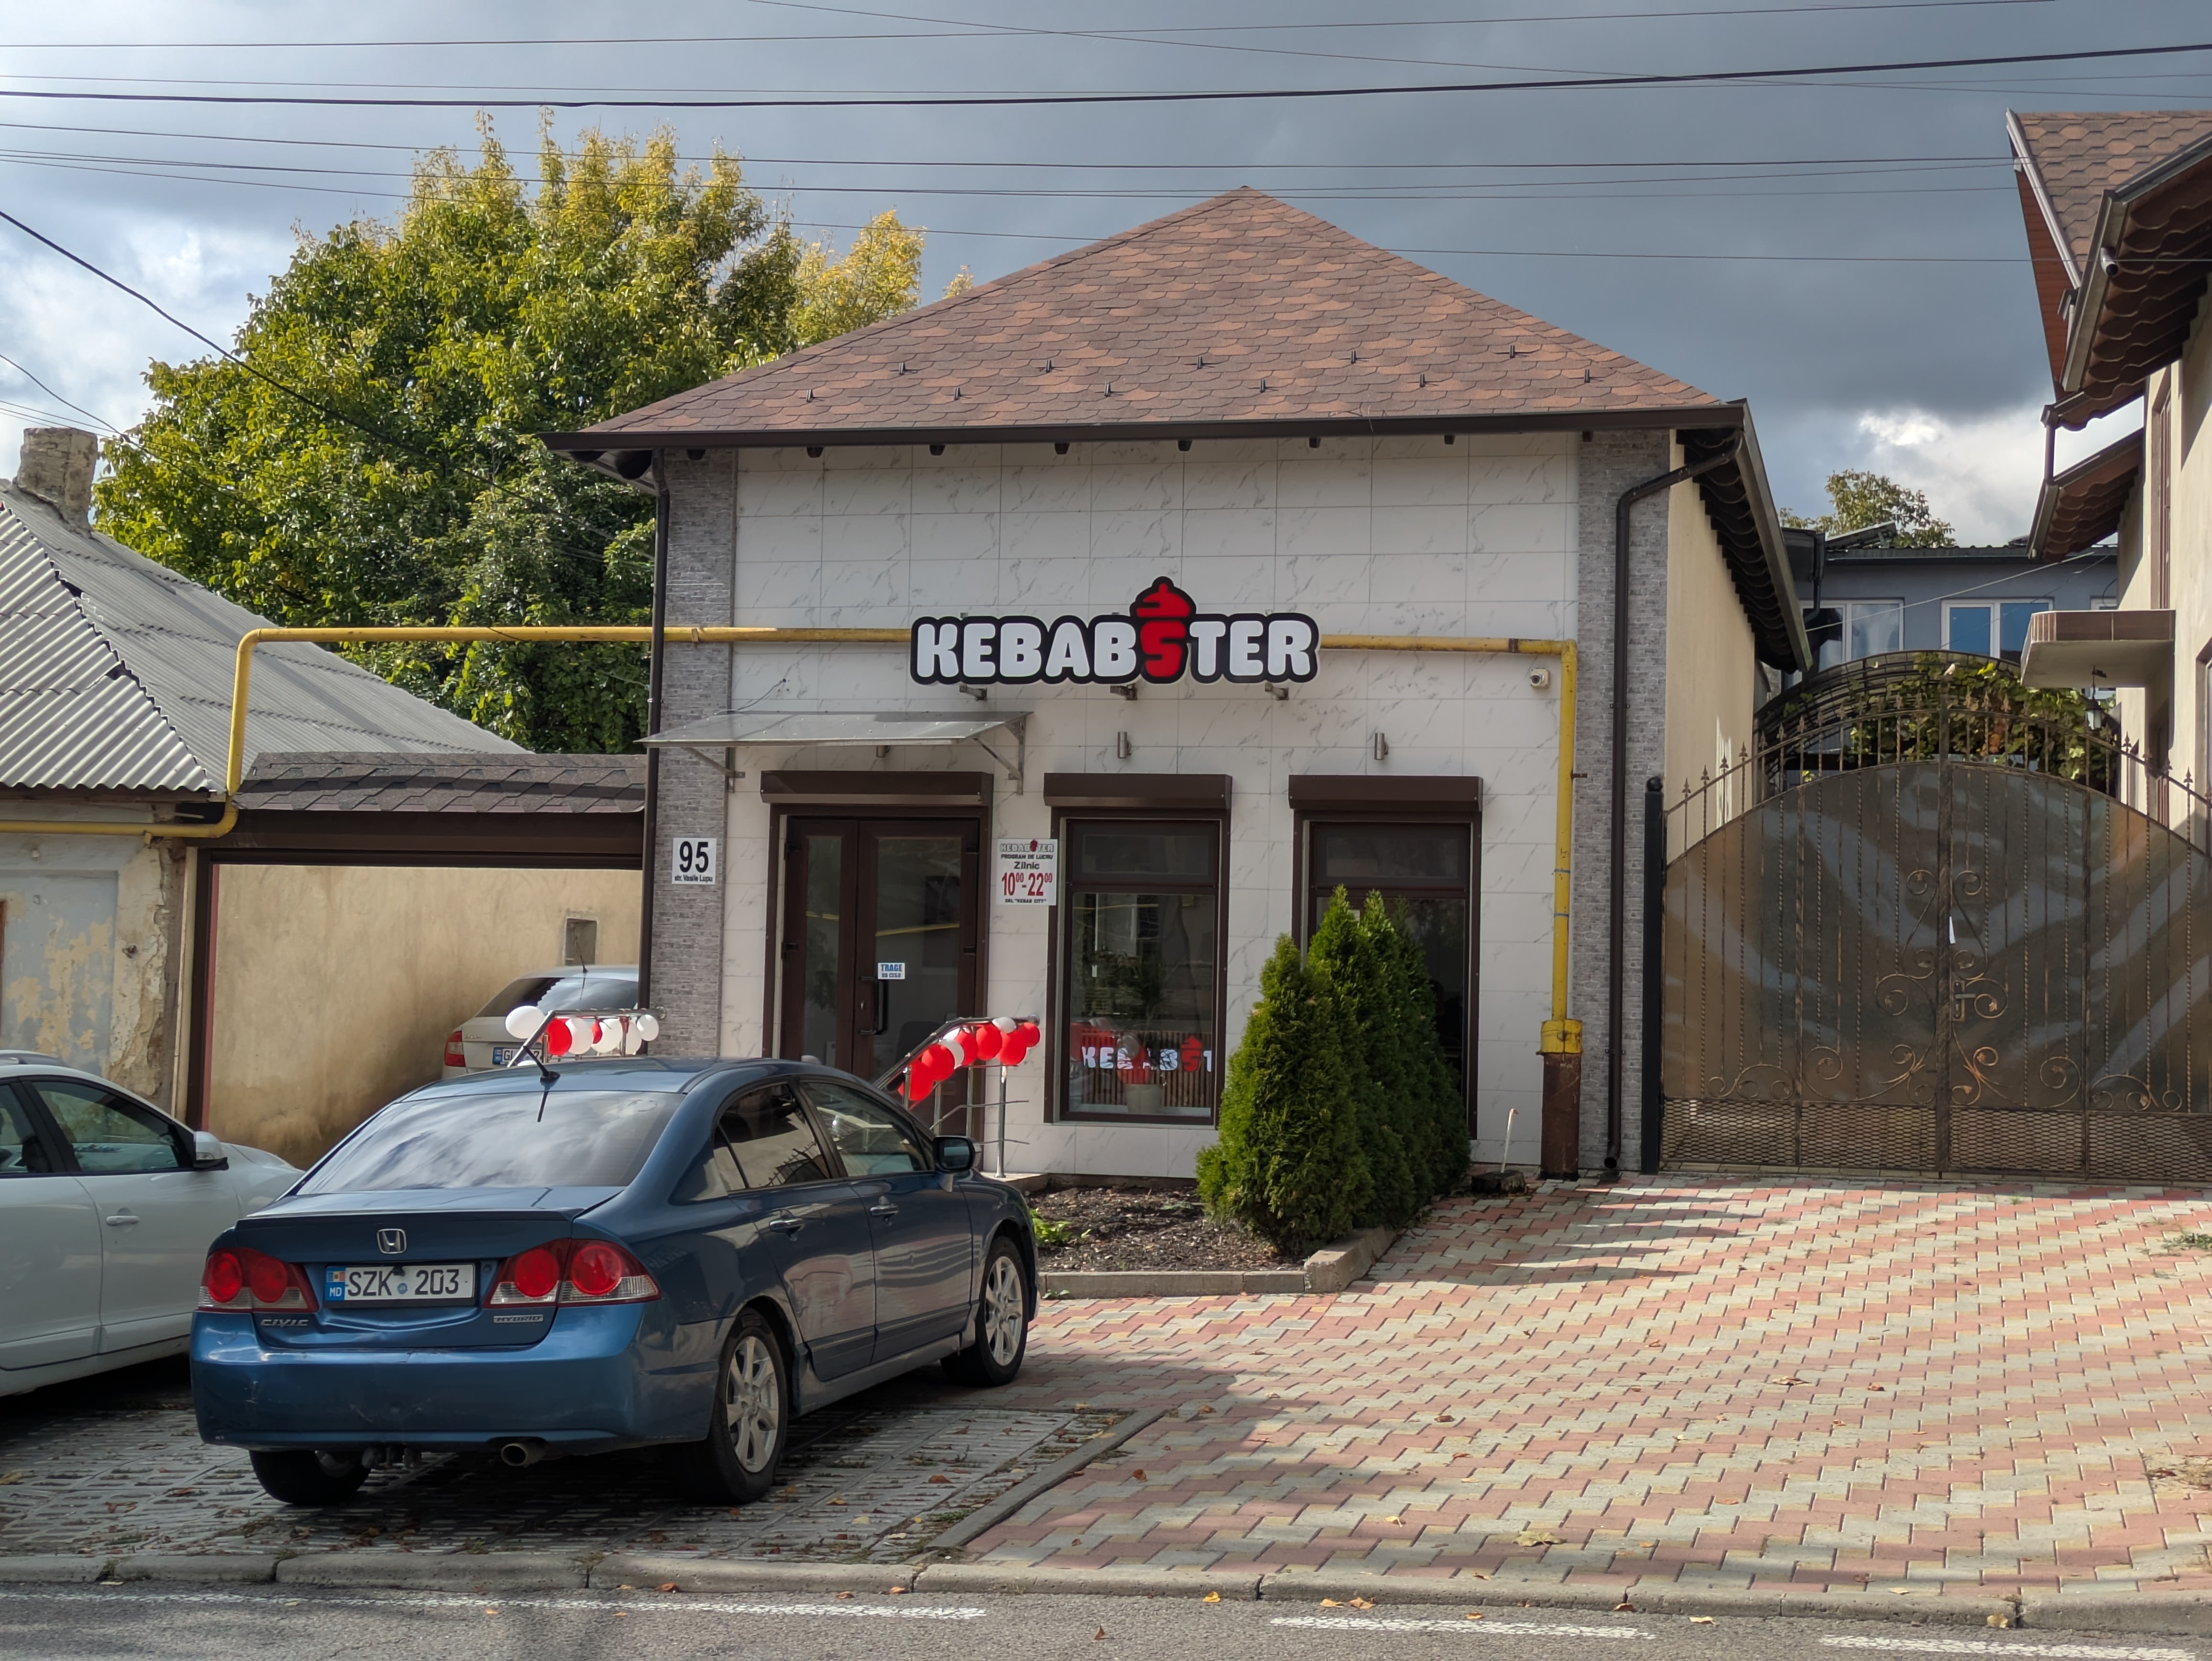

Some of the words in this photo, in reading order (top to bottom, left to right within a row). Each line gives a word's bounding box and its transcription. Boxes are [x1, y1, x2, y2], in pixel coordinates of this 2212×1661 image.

[913, 582, 1316, 680] KEBABSTER
[679, 841, 709, 873] 95
[699, 875, 713, 883] Lupu
[329, 1287, 342, 1297] MD
[347, 1271, 392, 1297] SZK
[414, 1269, 460, 1296] 203
